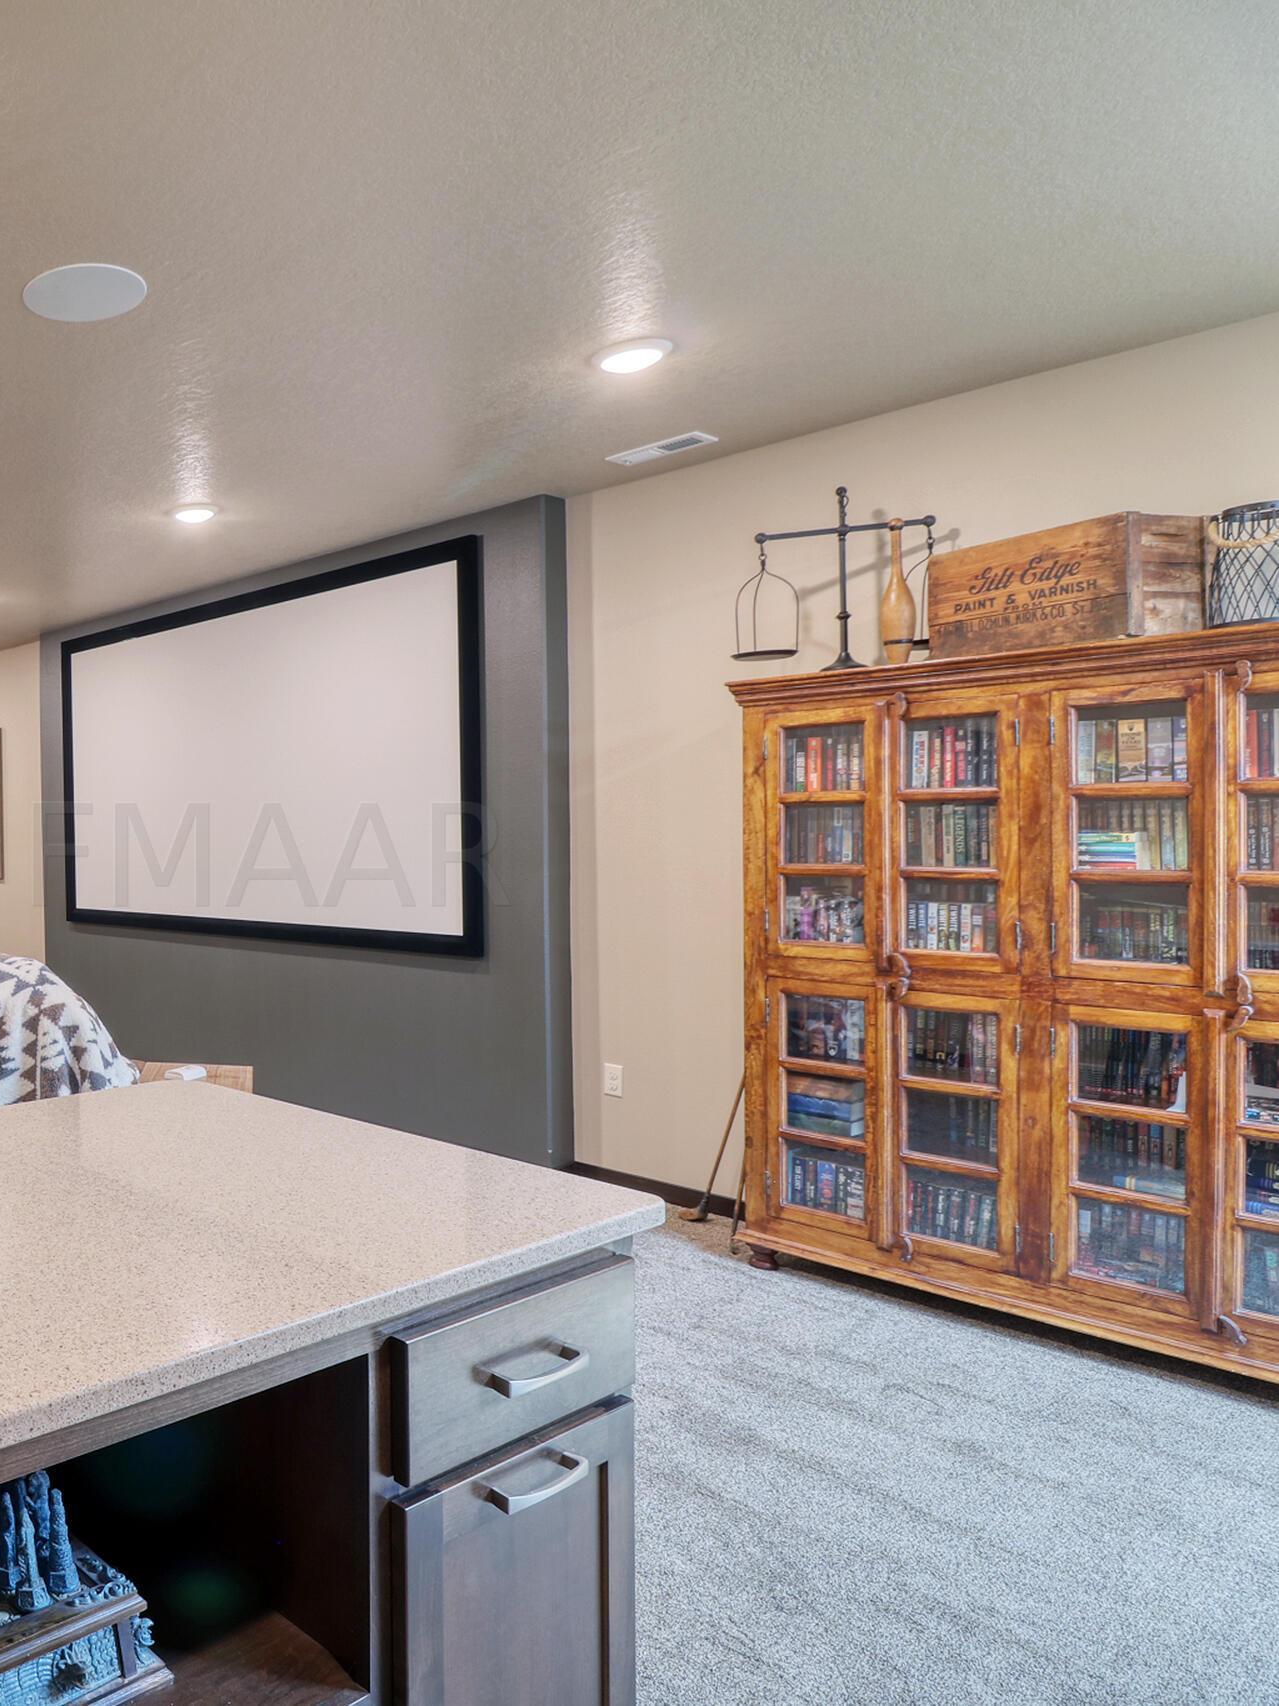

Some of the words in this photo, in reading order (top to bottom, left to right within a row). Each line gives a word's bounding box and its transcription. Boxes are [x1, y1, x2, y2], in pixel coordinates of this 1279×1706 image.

[969, 566, 1015, 596] Gilt
[1020, 556, 1082, 586] Edge
[953, 596, 996, 614] PAINT
[1005, 593, 1017, 605] &
[1027, 578, 1098, 601] VARNISH
[955, 814, 966, 853] LEGENDS
[949, 910, 959, 931] WHITE
